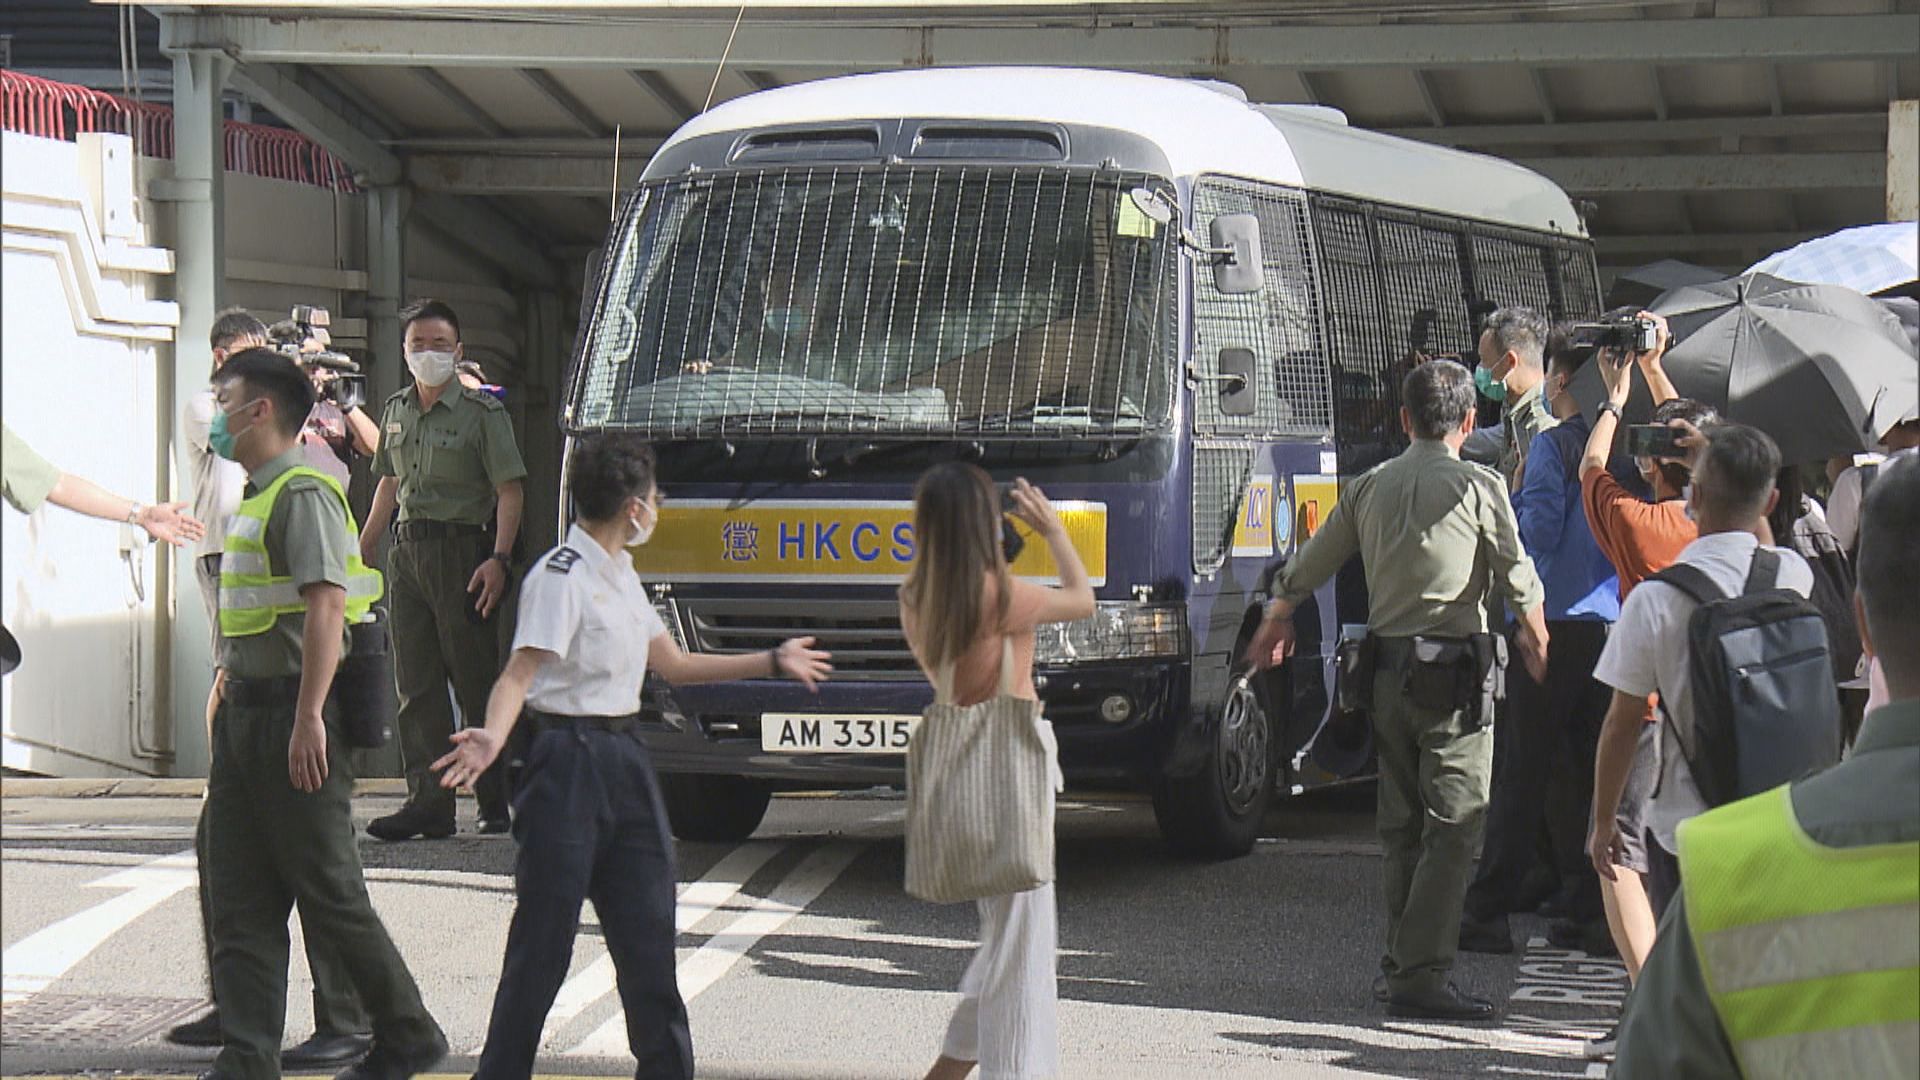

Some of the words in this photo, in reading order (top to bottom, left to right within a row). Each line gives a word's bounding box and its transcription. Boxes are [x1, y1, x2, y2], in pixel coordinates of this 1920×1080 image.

[722, 520, 760, 562] 懲
[779, 719, 821, 746] AM
[833, 720, 911, 747] 3315
